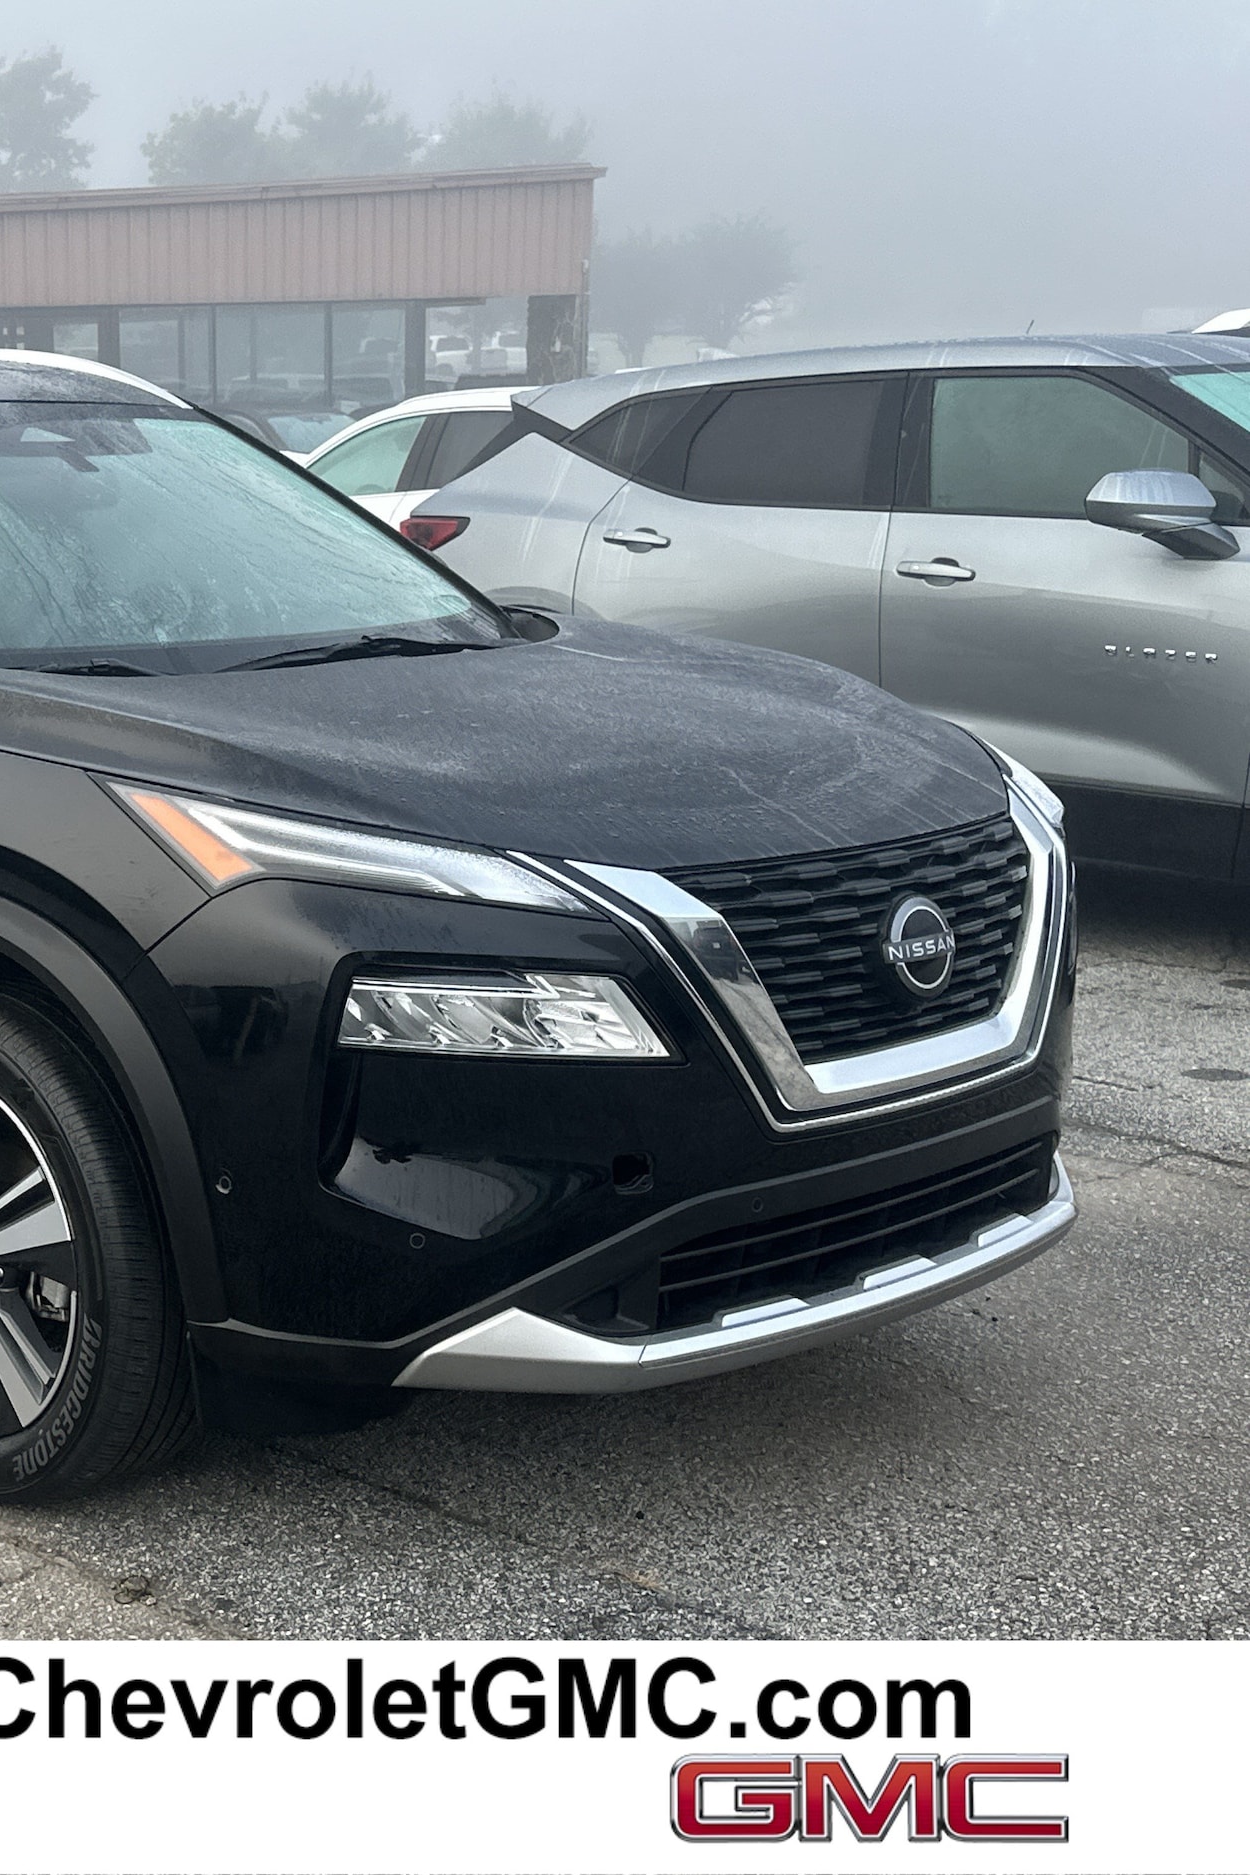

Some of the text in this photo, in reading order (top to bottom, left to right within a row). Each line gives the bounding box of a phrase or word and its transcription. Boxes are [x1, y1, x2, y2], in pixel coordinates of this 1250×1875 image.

[1104, 645, 1218, 664] BLAZER
[888, 935, 955, 961] NISSAN
[12, 1313, 102, 1481] BRIDGESTONE
